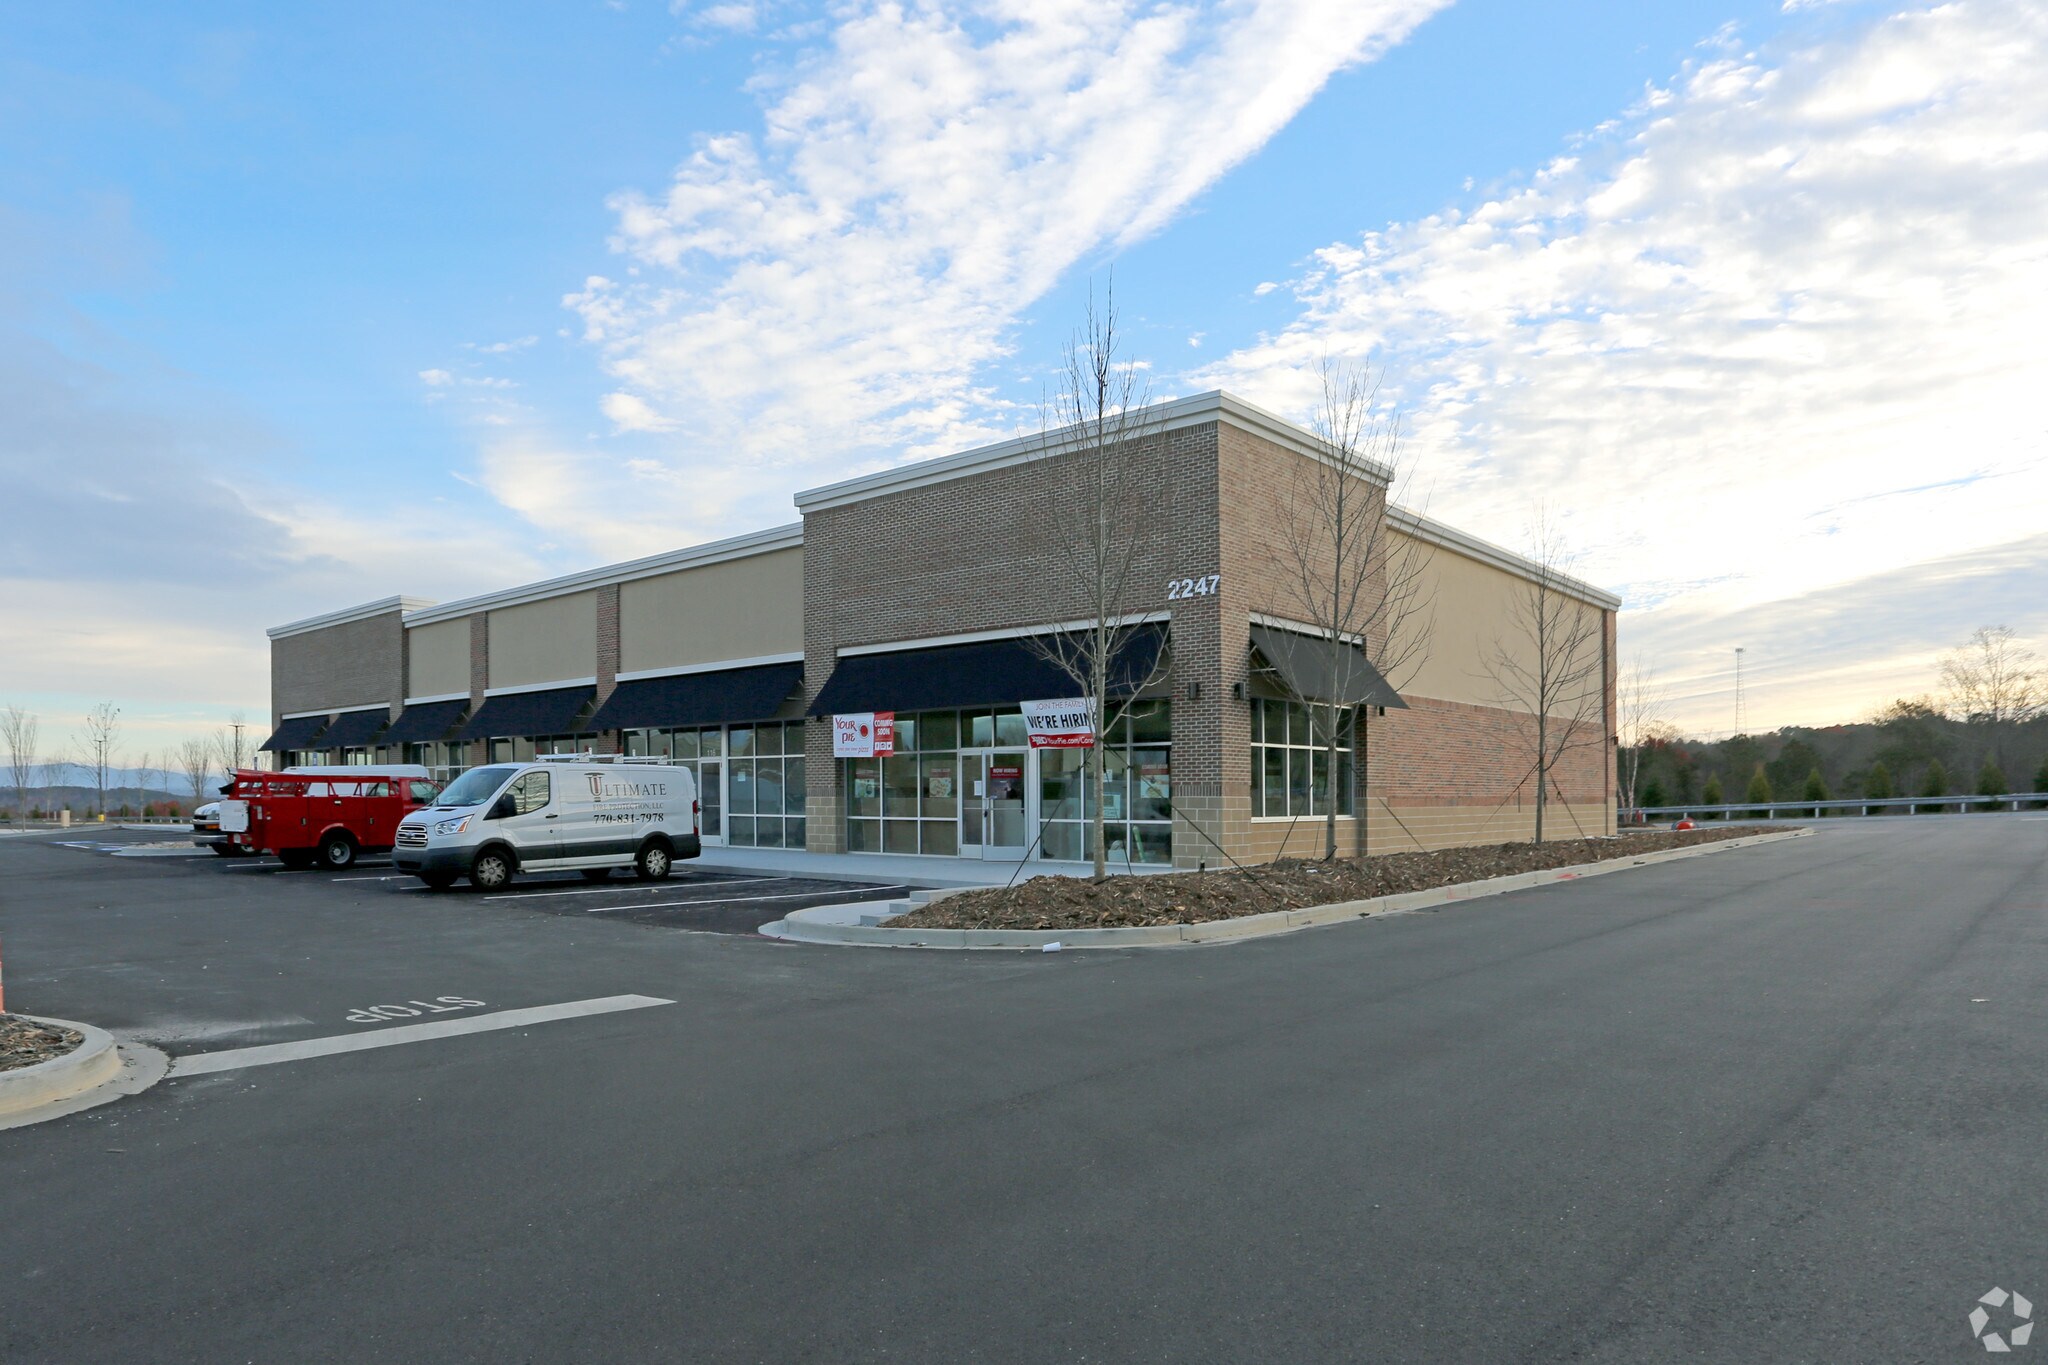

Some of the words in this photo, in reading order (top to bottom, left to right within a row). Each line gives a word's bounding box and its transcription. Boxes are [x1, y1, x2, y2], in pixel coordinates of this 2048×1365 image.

[1167, 574, 1220, 600] 2247
[1035, 703, 1051, 711] JOIN
[835, 717, 857, 731] YOUR
[874, 719, 893, 727] COMING
[1027, 715, 1058, 729] WE'RE
[586, 776, 667, 797] ULTIMATE
[592, 803, 608, 811] FIRE
[652, 802, 664, 810] LLC
[593, 813, 664, 824] 770-831-7978
[346, 996, 486, 1023] STOP
